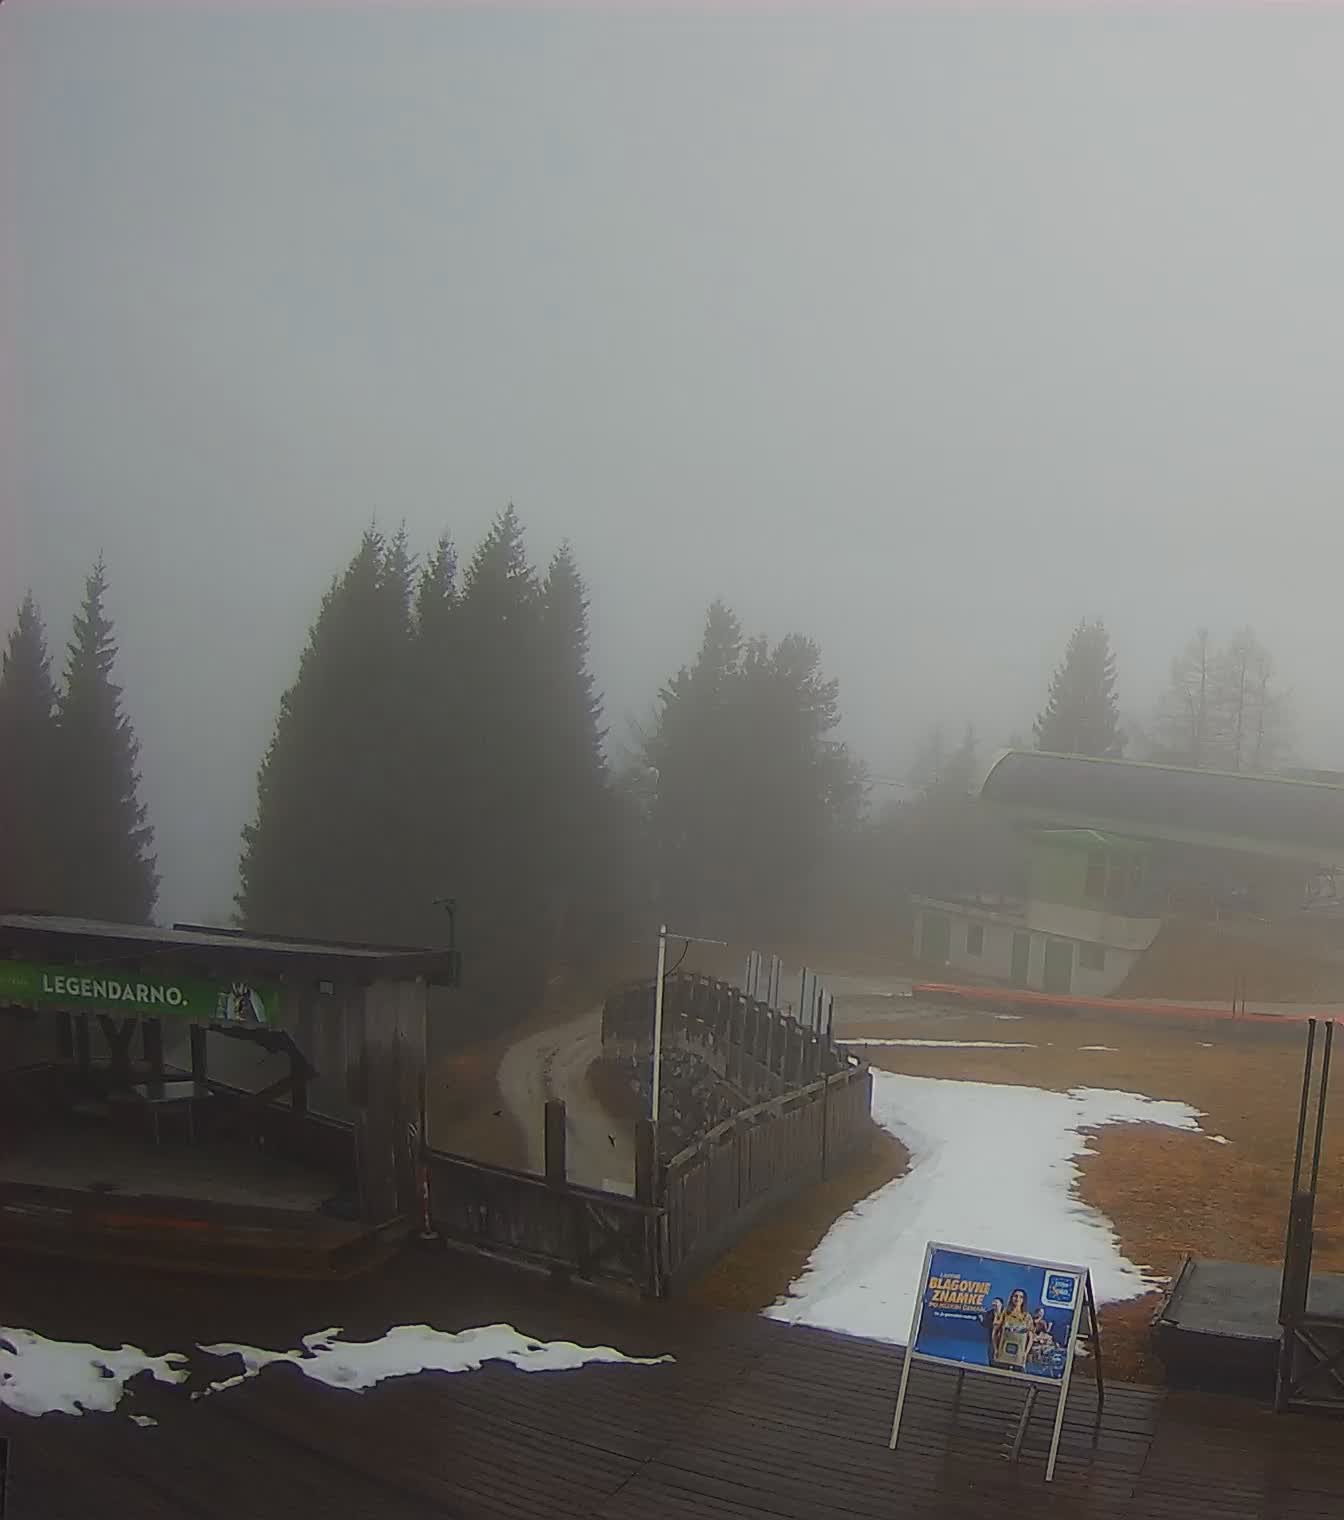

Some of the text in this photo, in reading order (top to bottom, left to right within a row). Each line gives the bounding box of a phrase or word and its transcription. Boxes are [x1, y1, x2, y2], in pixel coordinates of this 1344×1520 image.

[43, 973, 188, 1006] LEGENDARNO.
[928, 1276, 991, 1295] BLAGOVNE
[931, 1289, 984, 1305] ZNAMKE
